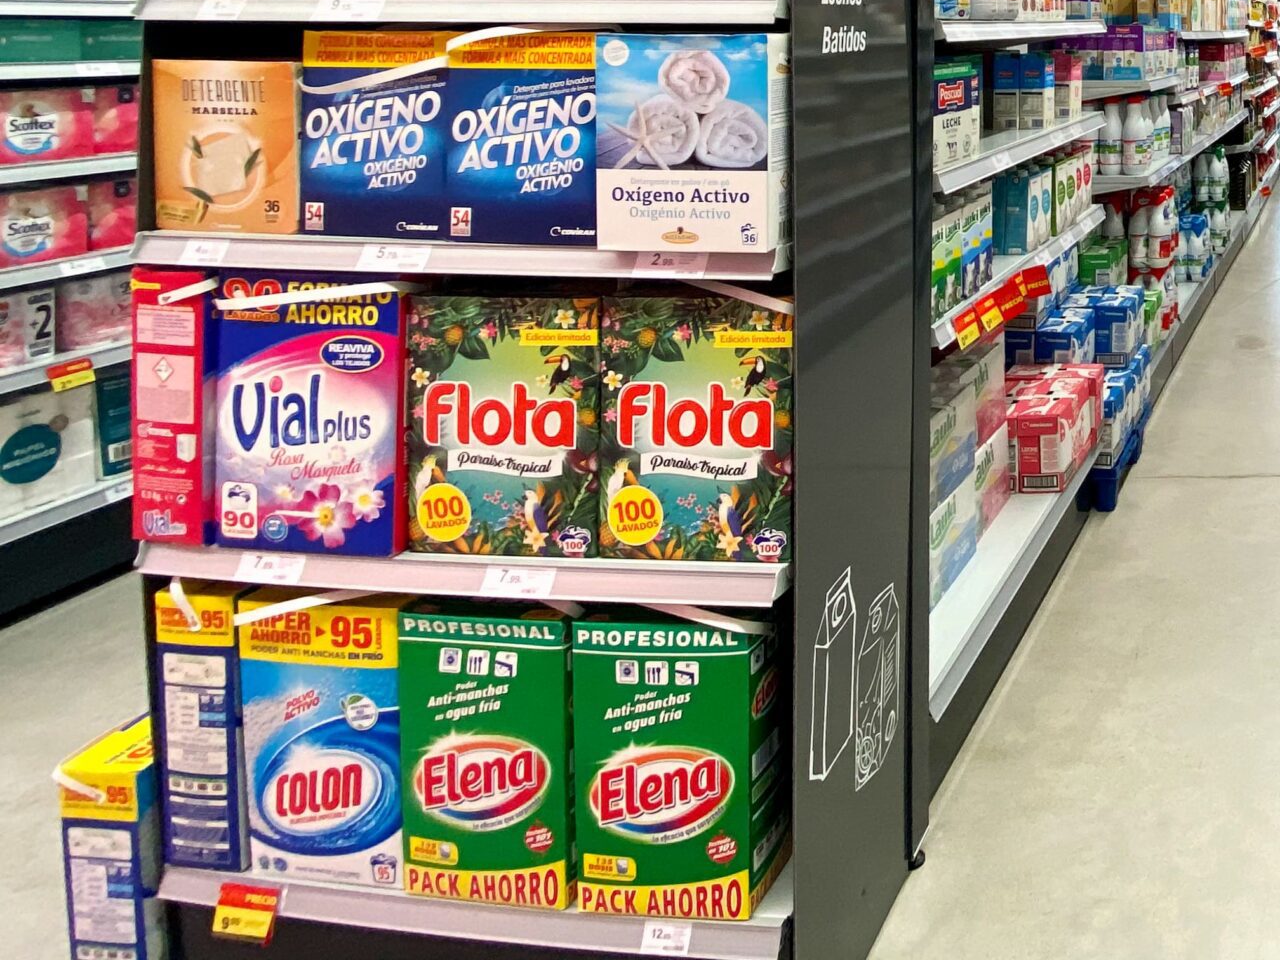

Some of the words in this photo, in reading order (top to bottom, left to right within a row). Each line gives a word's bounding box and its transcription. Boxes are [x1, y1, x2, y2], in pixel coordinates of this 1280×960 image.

[528, 35, 593, 48] CONCENTRADA
[822, 25, 866, 53] Batidos
[528, 52, 593, 64] CONCENTRADA
[182, 79, 265, 103] DETERGENTE
[514, 82, 549, 94] Detergente
[566, 76, 594, 86] lavadora
[191, 107, 258, 116] MARSELLA
[305, 91, 441, 139] OXÍGENO
[452, 92, 596, 142] OXÍGENO
[942, 117, 961, 129] LECHE
[310, 124, 424, 169] ACTIVO
[457, 126, 580, 174] ACTIVO
[364, 155, 427, 176] OXIGÉNIO
[516, 158, 584, 179] OXIGÉNIO
[368, 170, 417, 190] ACTIVO
[520, 174, 572, 193] ACTIVO
[612, 187, 685, 206] Oxígeno
[691, 188, 750, 204] Activo
[264, 200, 280, 213] 36
[306, 204, 323, 221] 54
[629, 206, 686, 221] Oxigénio
[689, 208, 731, 220] Activo
[452, 210, 469, 227] 54
[744, 234, 756, 243] 36
[285, 305, 379, 326] AHORRO
[525, 333, 557, 341] Edición
[558, 333, 592, 341] limitada
[720, 334, 750, 343] Edición
[751, 335, 786, 343] limitada
[329, 344, 375, 353] REAVIVA
[233, 374, 320, 452] Vial
[324, 410, 371, 443] plus
[267, 447, 304, 467] Rosa
[291, 457, 360, 481] Mosqueta
[505, 457, 552, 476] tropical
[699, 460, 747, 479] tropical
[423, 496, 463, 520] 100
[614, 499, 655, 523] 100
[224, 511, 254, 528] 90
[426, 515, 467, 529] LAVADOS
[616, 519, 659, 533] LAVADOS
[565, 542, 583, 550] 100
[760, 544, 778, 553] 100
[203, 610, 225, 628] 95
[250, 628, 311, 645] AHORRO
[251, 612, 311, 631] HIPER
[330, 617, 373, 648] 95
[403, 618, 555, 640] PROFESIONAL
[577, 629, 739, 647] PROFESIONAL
[251, 645, 279, 654] PODER
[282, 647, 300, 656] ANTI
[303, 649, 346, 660] MANCHAS
[456, 681, 478, 691] Poder
[286, 690, 315, 709] POLVO
[427, 683, 510, 708] Anti-manchas
[634, 691, 657, 702] Poder
[284, 697, 320, 721] ACTIVO
[445, 704, 476, 721] agua
[604, 692, 691, 720] Anti-manchas
[612, 725, 622, 733] en
[624, 718, 656, 732] agua
[423, 750, 537, 809] Elena
[106, 786, 128, 803] 95
[600, 759, 719, 825] Elena
[660, 831, 685, 843] eficacia
[685, 827, 697, 836] que
[377, 867, 390, 880] 95
[409, 868, 460, 897] PACK
[470, 868, 558, 907] AHORRO
[582, 887, 638, 914] PACK
[647, 879, 742, 918] AHORRO
